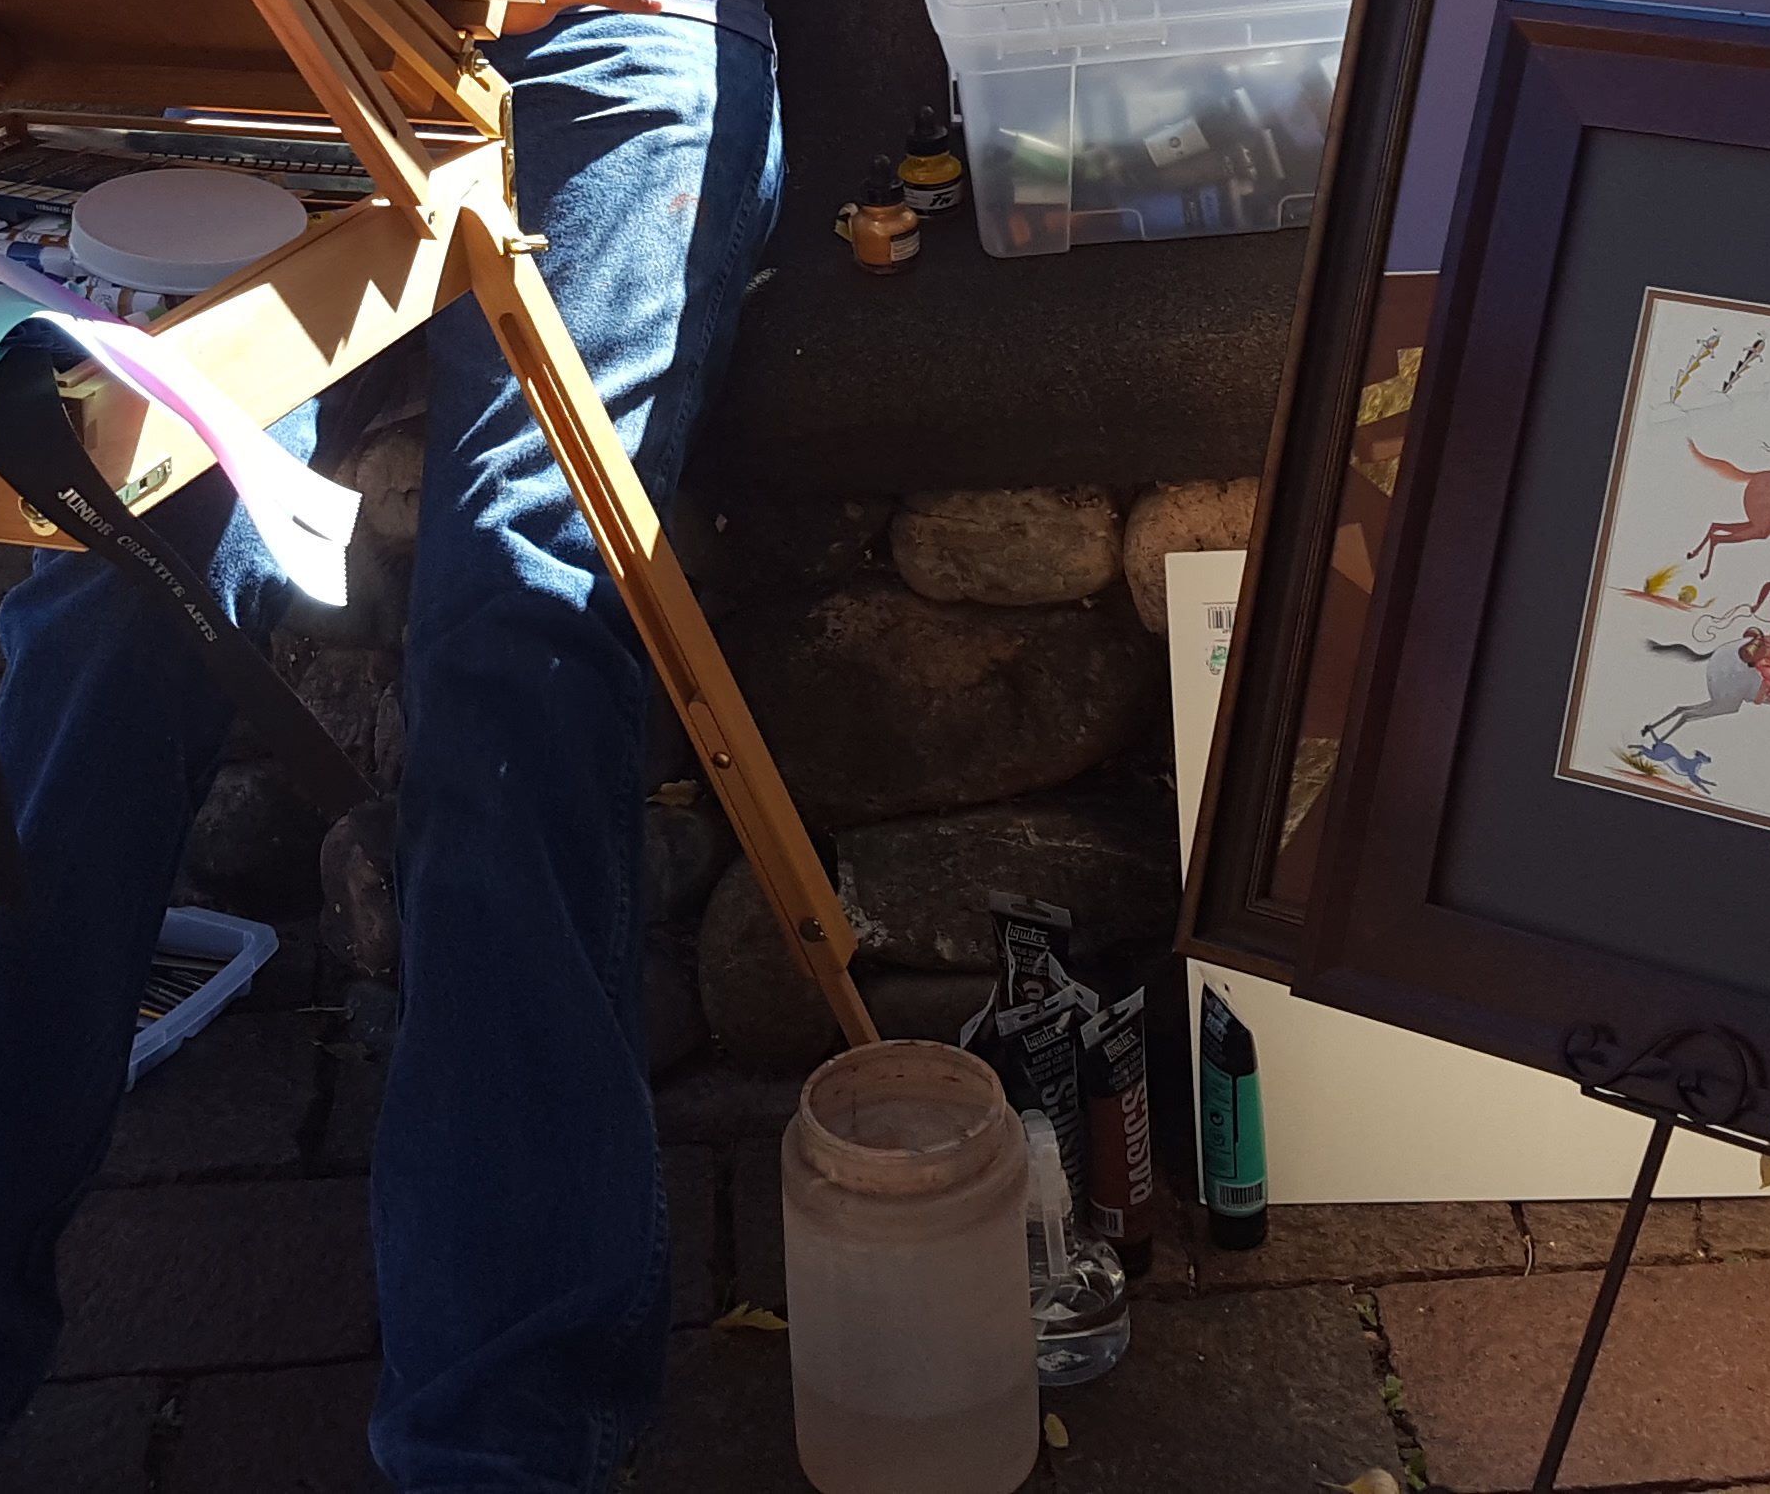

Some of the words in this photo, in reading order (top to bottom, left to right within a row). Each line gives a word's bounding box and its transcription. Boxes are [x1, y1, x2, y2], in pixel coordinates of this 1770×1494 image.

[57, 487, 114, 536] JUNIOR
[116, 535, 186, 598] CREATIVE
[183, 602, 218, 642] ARTS
[1022, 1022, 1071, 1054] Liquite
